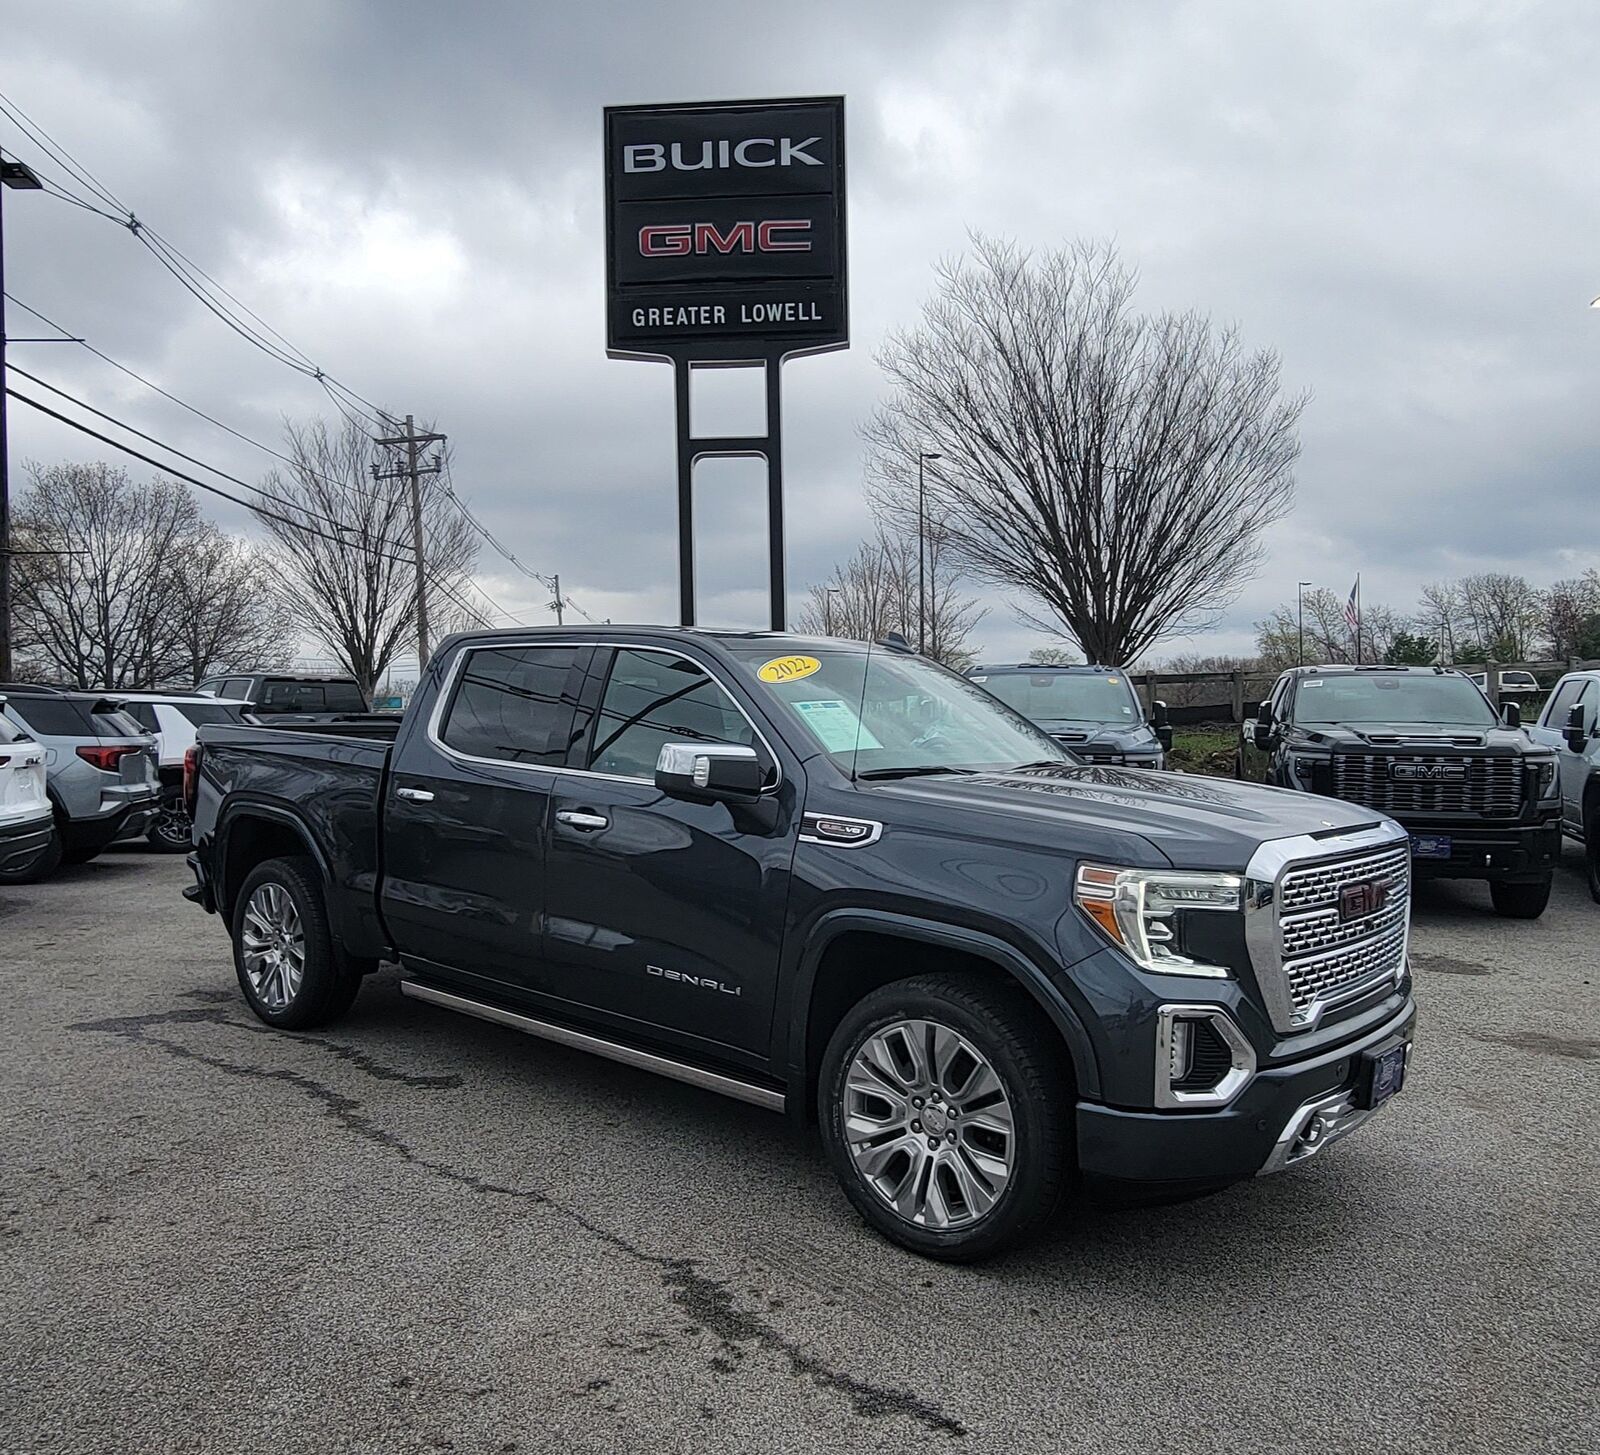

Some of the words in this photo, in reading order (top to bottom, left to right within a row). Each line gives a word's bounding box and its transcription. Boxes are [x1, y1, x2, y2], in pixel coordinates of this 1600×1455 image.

[623, 136, 825, 173] BUICK
[638, 219, 812, 257] GMC
[632, 306, 726, 327] GREATER
[741, 302, 822, 323] LOWELL
[768, 657, 811, 680] 2022
[1394, 765, 1465, 778] GMC
[646, 965, 741, 996] DENALI
